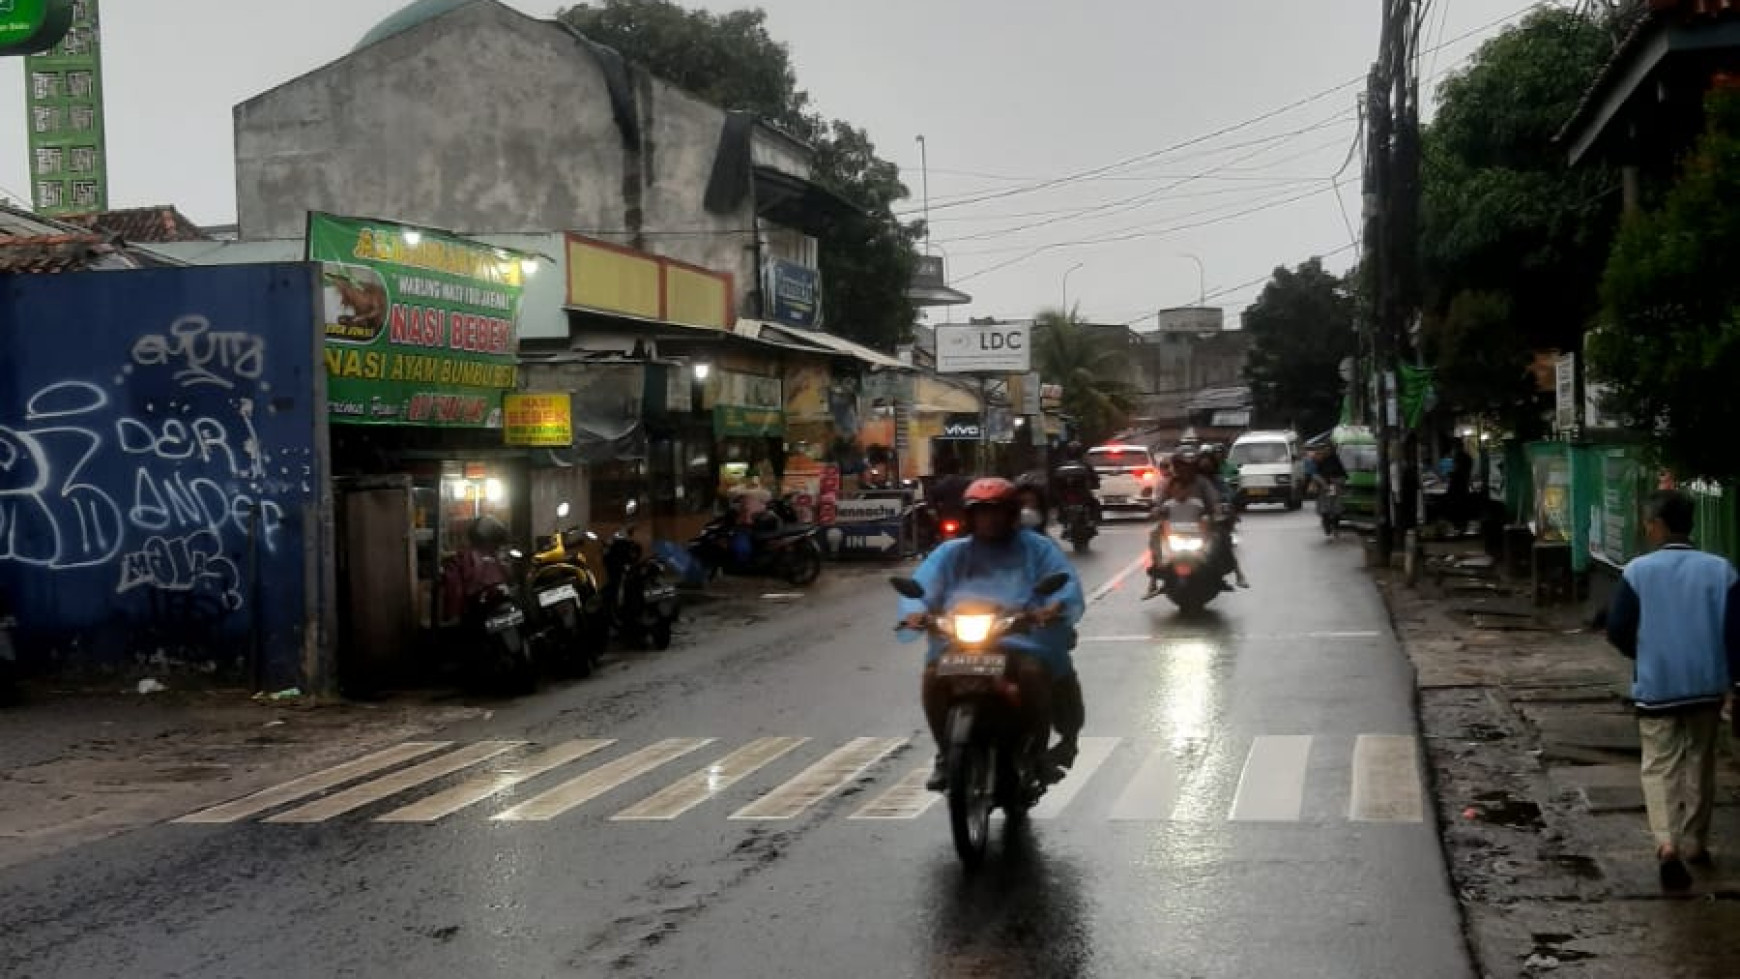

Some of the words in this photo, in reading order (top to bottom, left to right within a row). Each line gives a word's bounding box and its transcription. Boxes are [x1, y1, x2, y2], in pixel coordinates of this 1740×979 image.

[389, 303, 445, 347] NASI
[450, 311, 512, 355] BEBEK
[981, 330, 1022, 351] LDC
[324, 347, 386, 379] NASI
[391, 354, 437, 383] AYAM
[945, 423, 979, 436] vivo
[846, 535, 865, 548] IN
